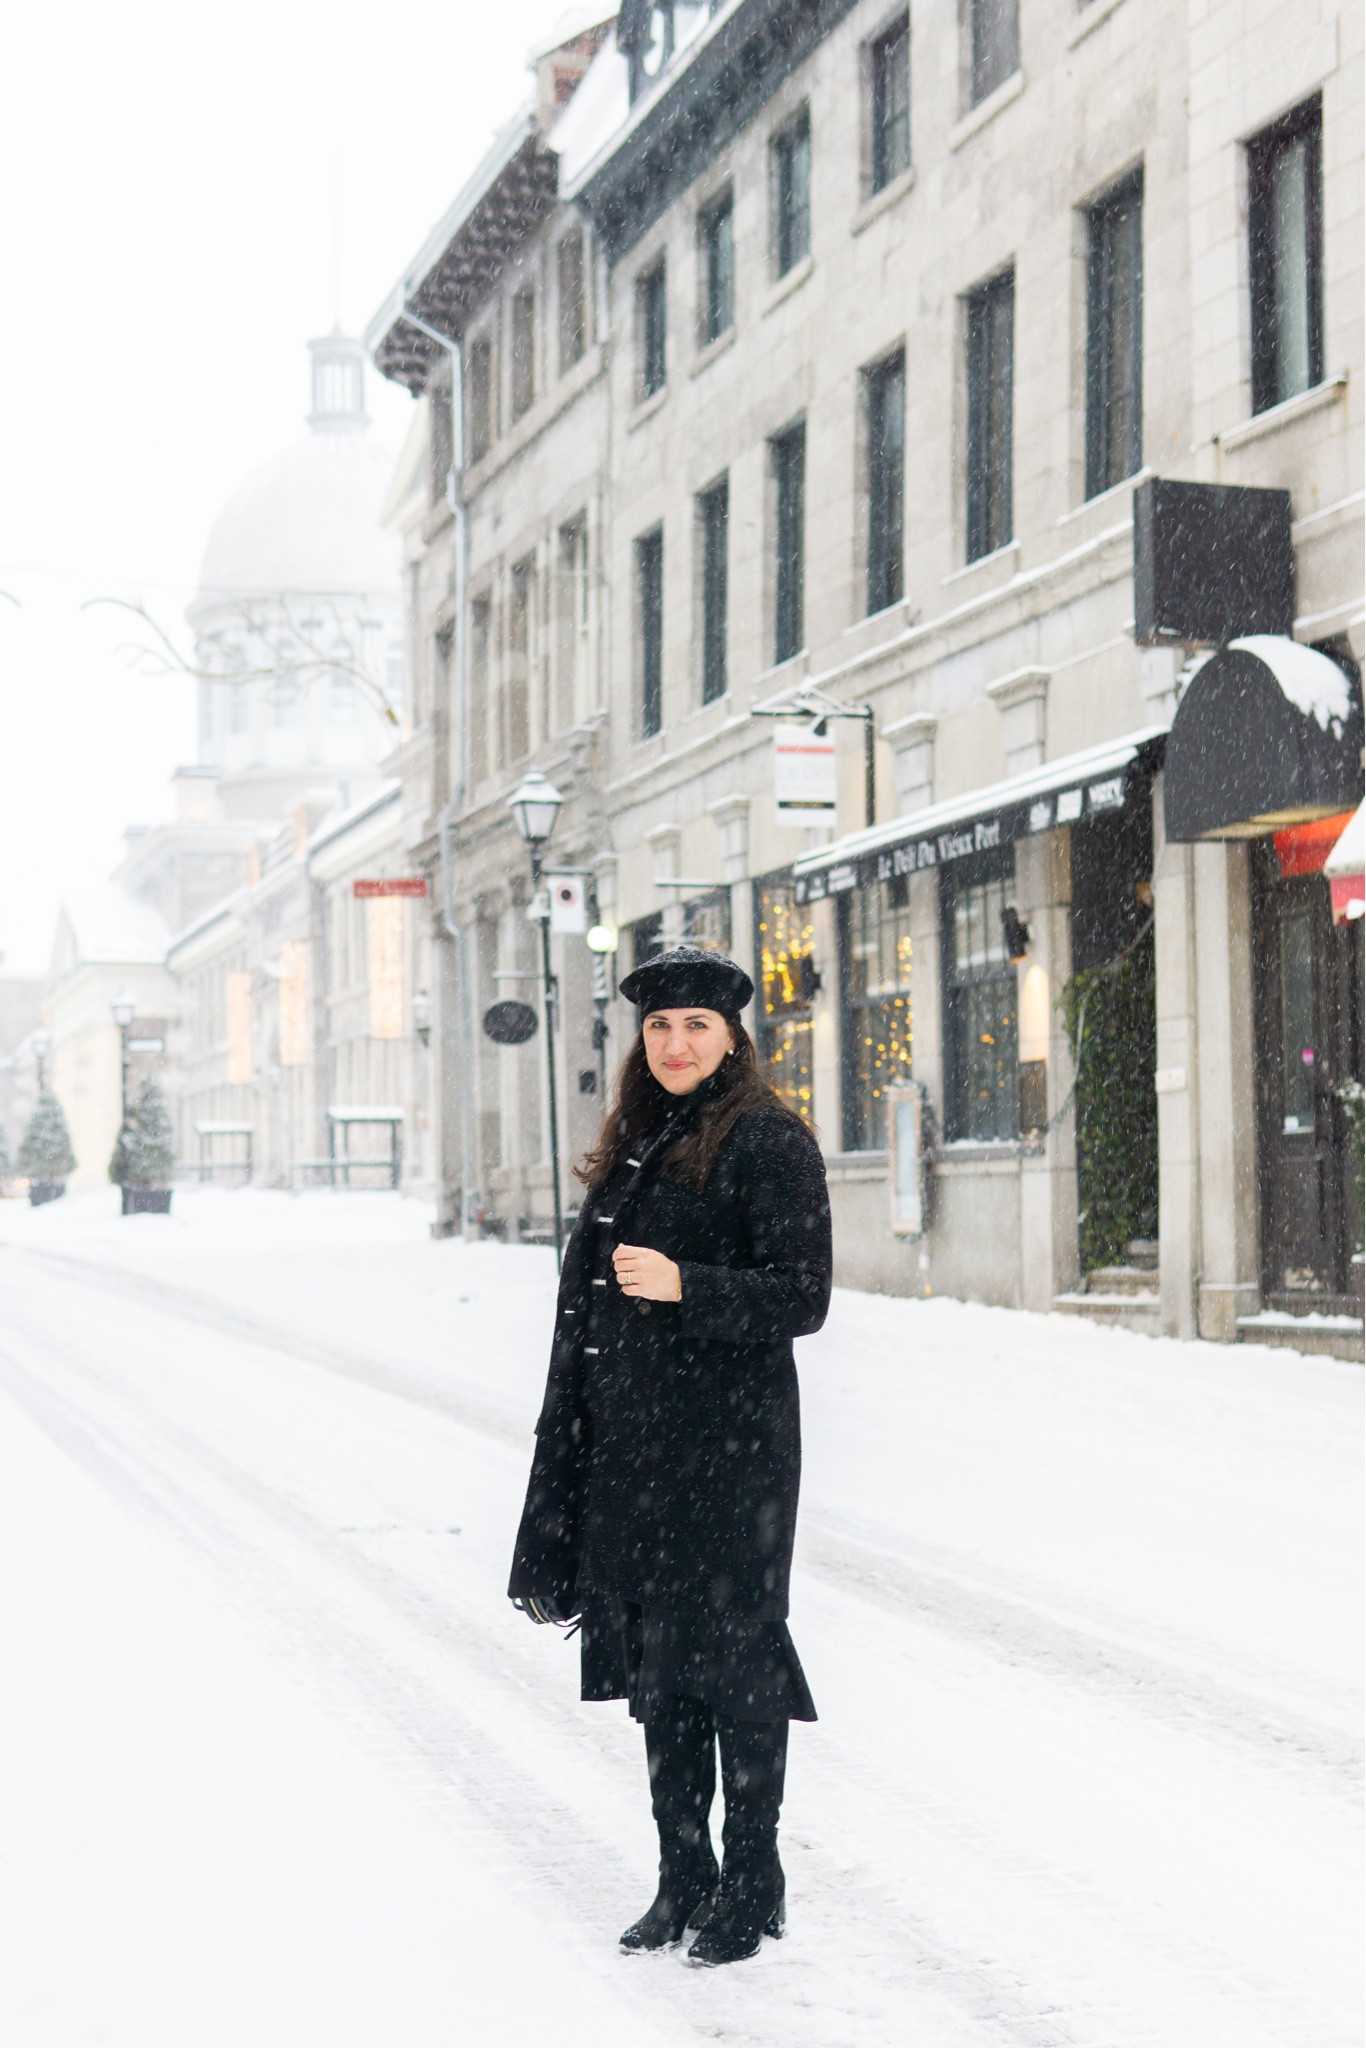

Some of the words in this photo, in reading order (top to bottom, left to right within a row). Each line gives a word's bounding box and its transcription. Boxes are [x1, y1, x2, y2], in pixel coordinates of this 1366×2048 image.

[878, 855, 892, 880] Le
[917, 840, 936, 868] Du
[938, 833, 973, 860] Vieux
[974, 821, 1000, 851] Port
